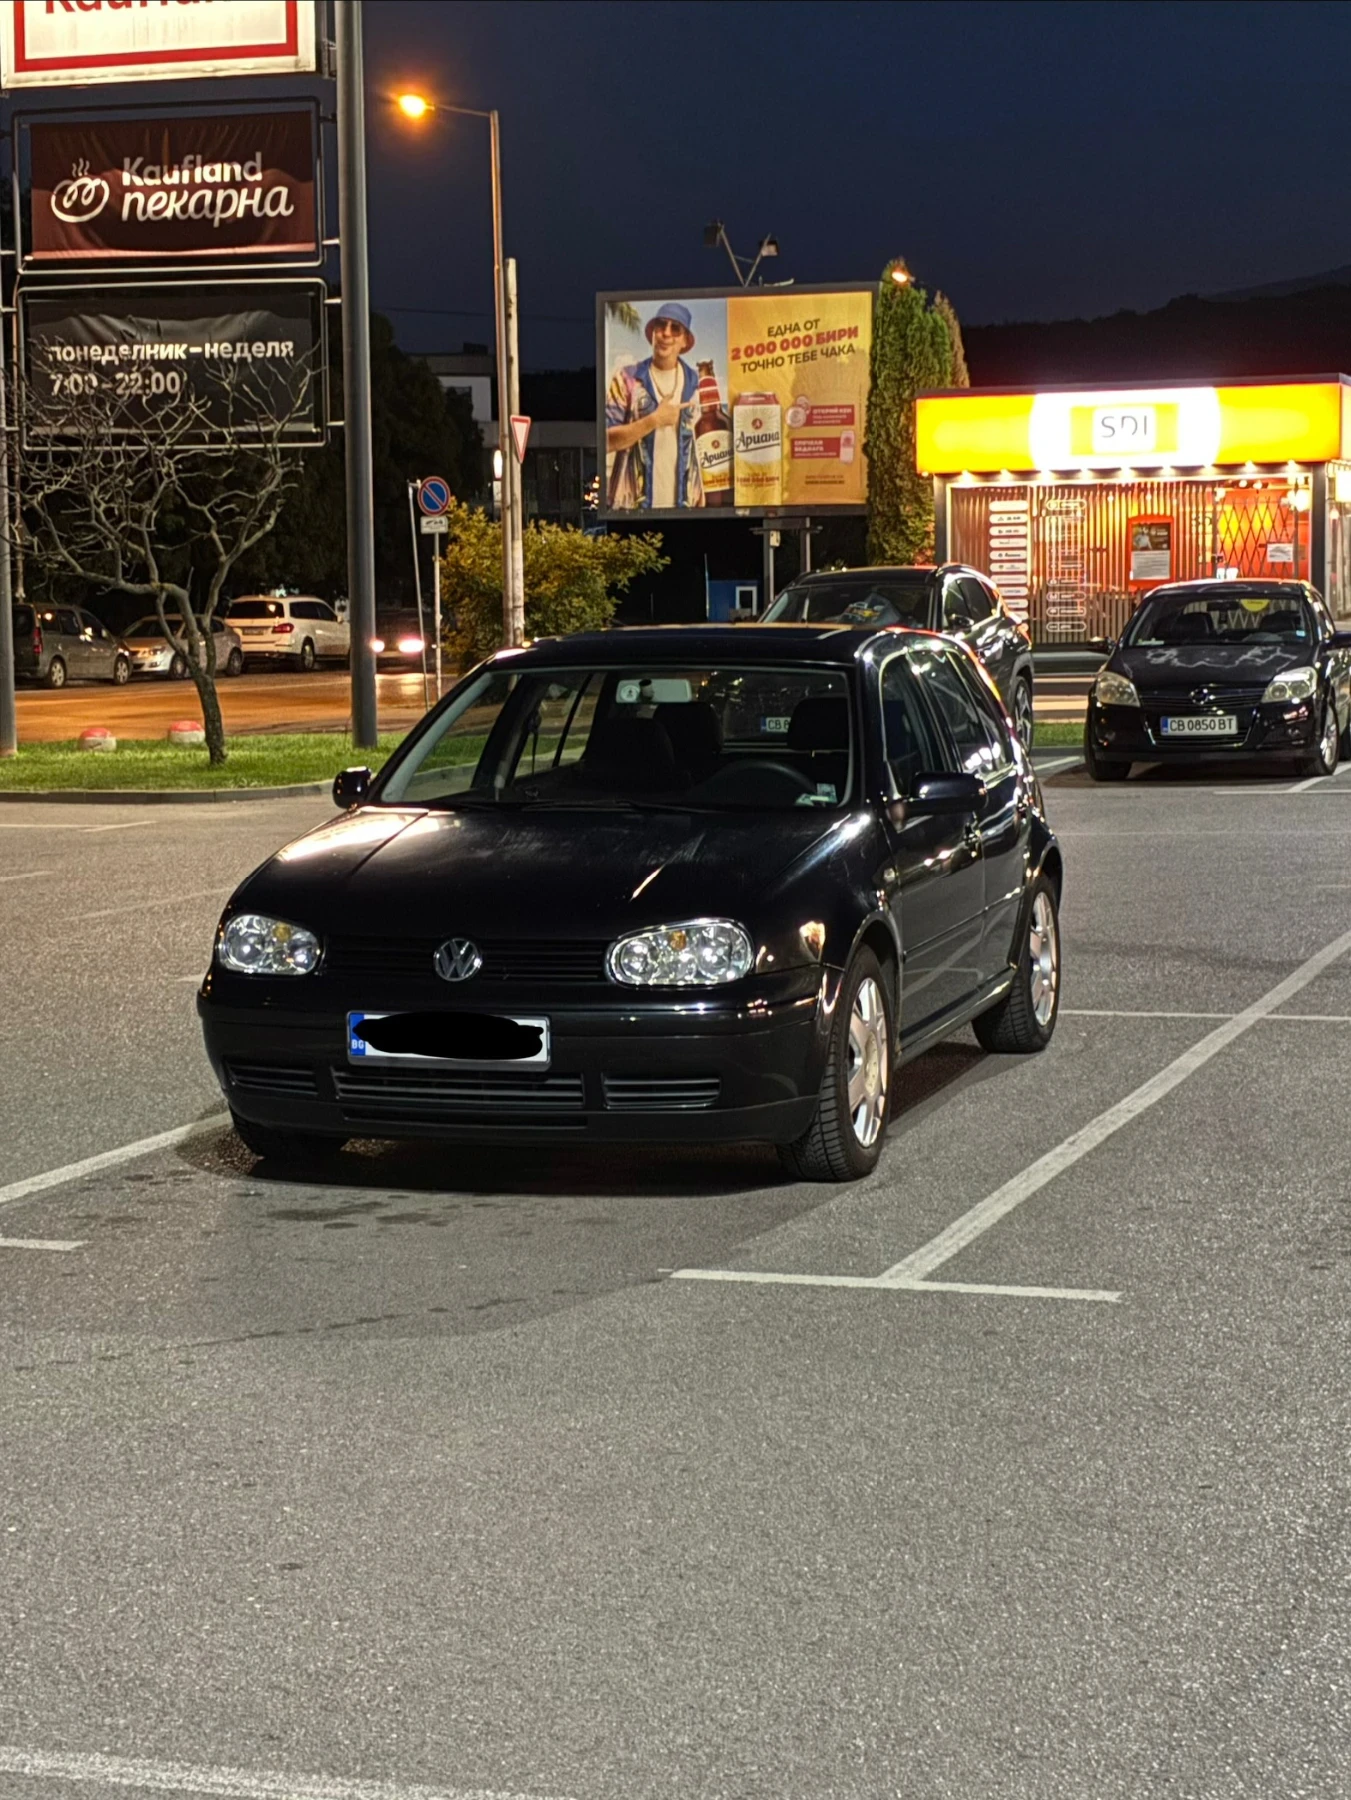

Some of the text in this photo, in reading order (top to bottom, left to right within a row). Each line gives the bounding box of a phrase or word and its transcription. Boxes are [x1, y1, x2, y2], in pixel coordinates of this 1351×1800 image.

[121, 151, 263, 187] Kaufland
[121, 185, 294, 228] пекарна
[731, 325, 859, 361] 2 000 000 БИРИ
[767, 318, 821, 338] ЕДНА ОТ
[741, 343, 856, 374] ТОЧНО ТЕБЕ ЧАКА
[736, 430, 780, 450] Ариана
[1187, 718, 1217, 731] 0850
